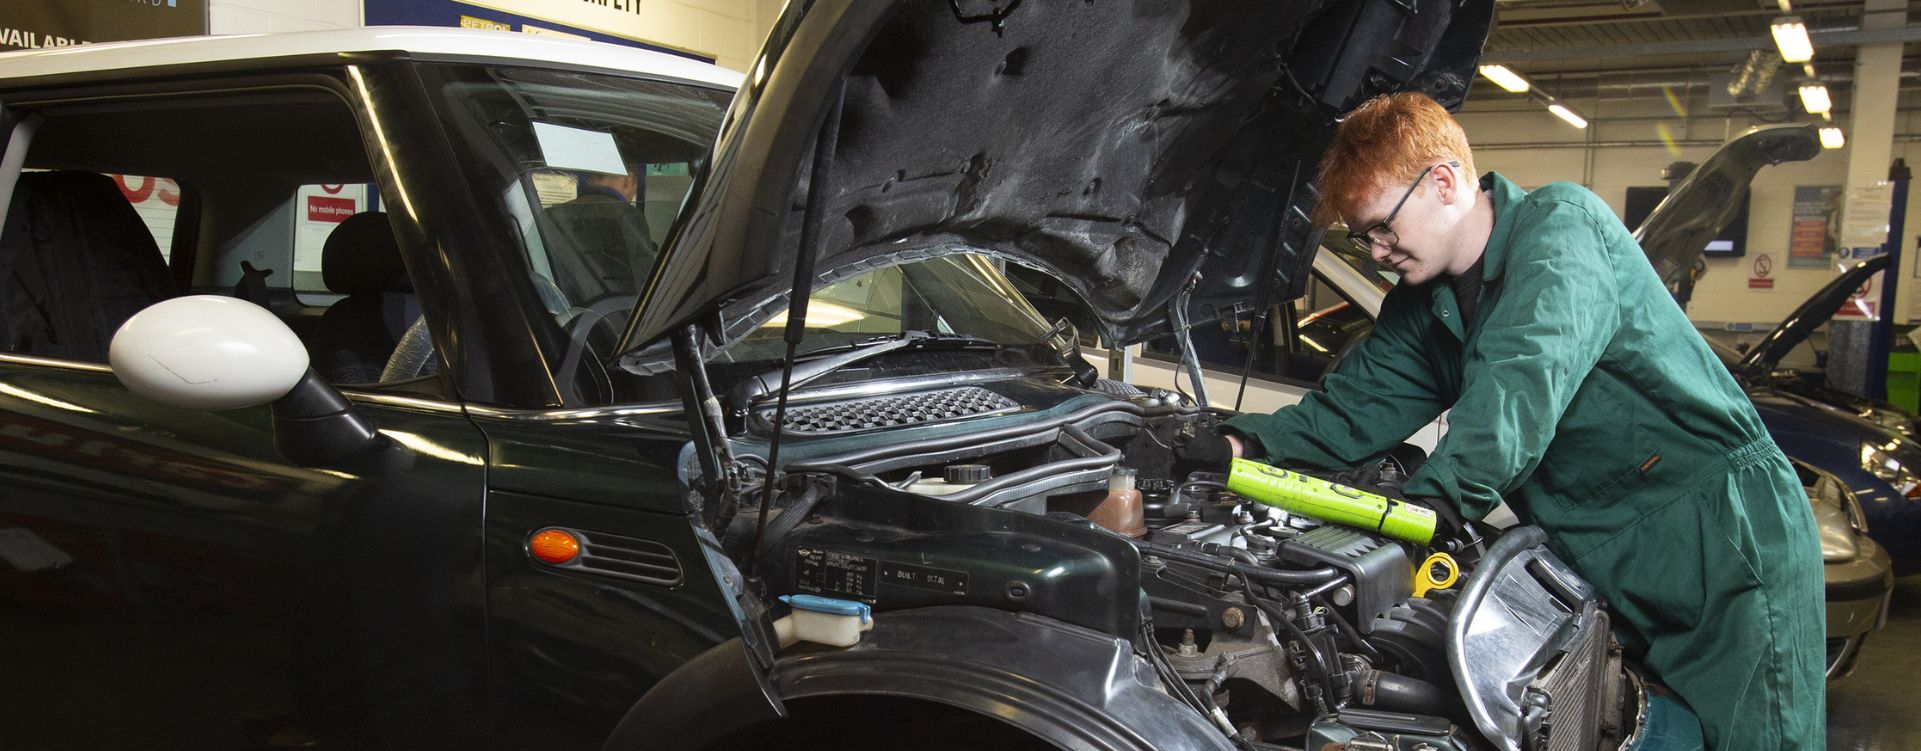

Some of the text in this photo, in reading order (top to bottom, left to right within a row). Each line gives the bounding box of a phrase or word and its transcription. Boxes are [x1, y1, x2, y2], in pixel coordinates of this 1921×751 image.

[310, 204, 354, 216] No mobile phones
[897, 570, 916, 580] BUILT
